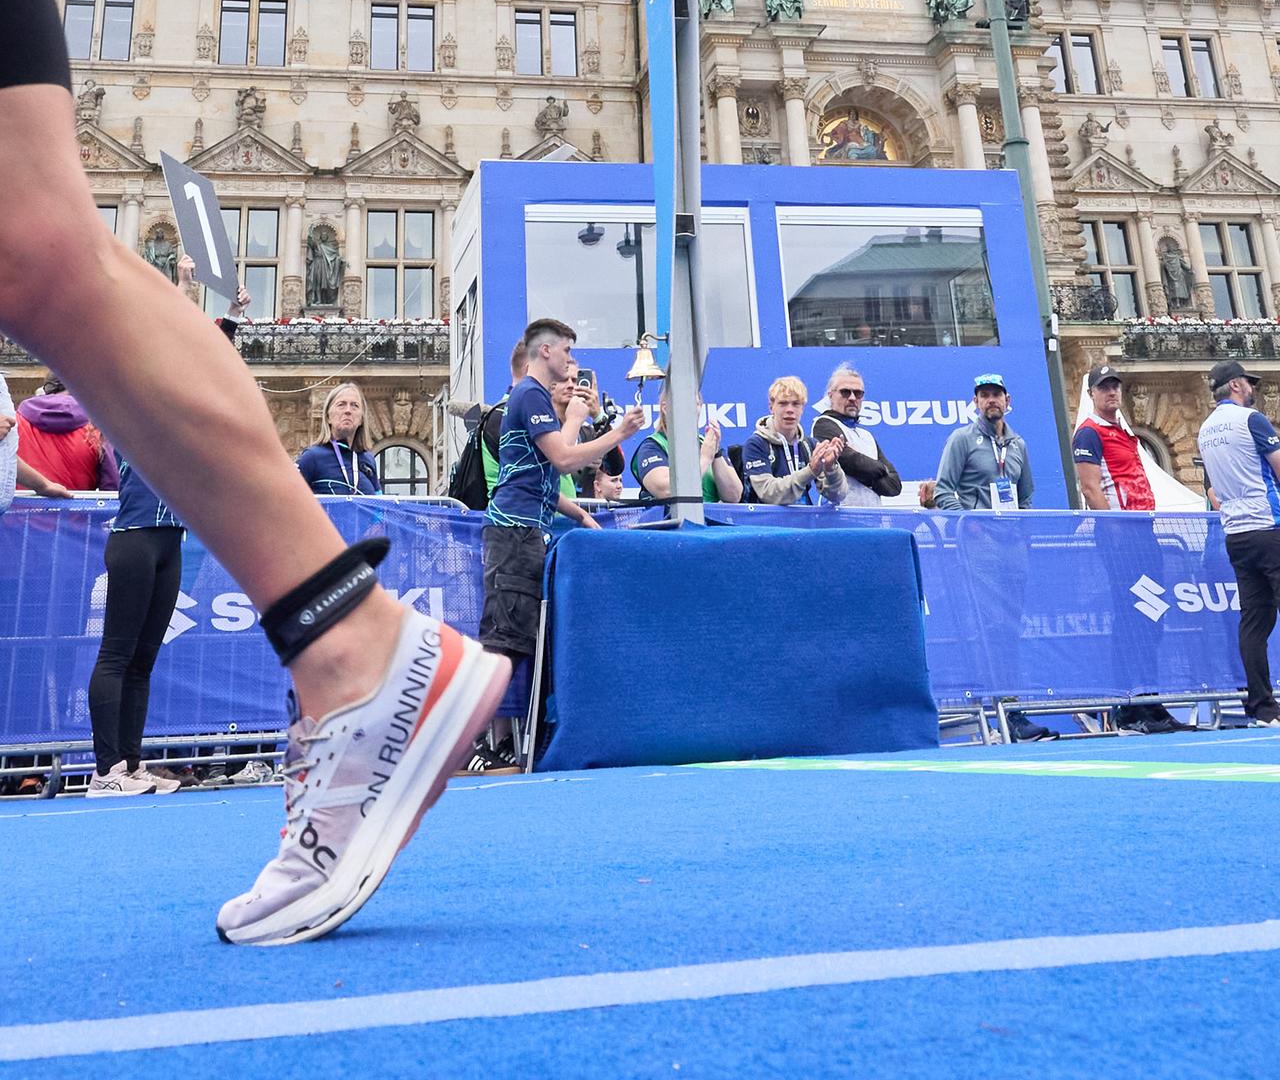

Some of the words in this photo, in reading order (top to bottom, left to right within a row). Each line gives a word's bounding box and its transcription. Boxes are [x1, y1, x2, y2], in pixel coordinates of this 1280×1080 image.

[184, 181, 222, 279] 1
[858, 400, 979, 426] SUZUK
[1174, 582, 1241, 612] SUZ
[378, 627, 442, 767] RUNNING
